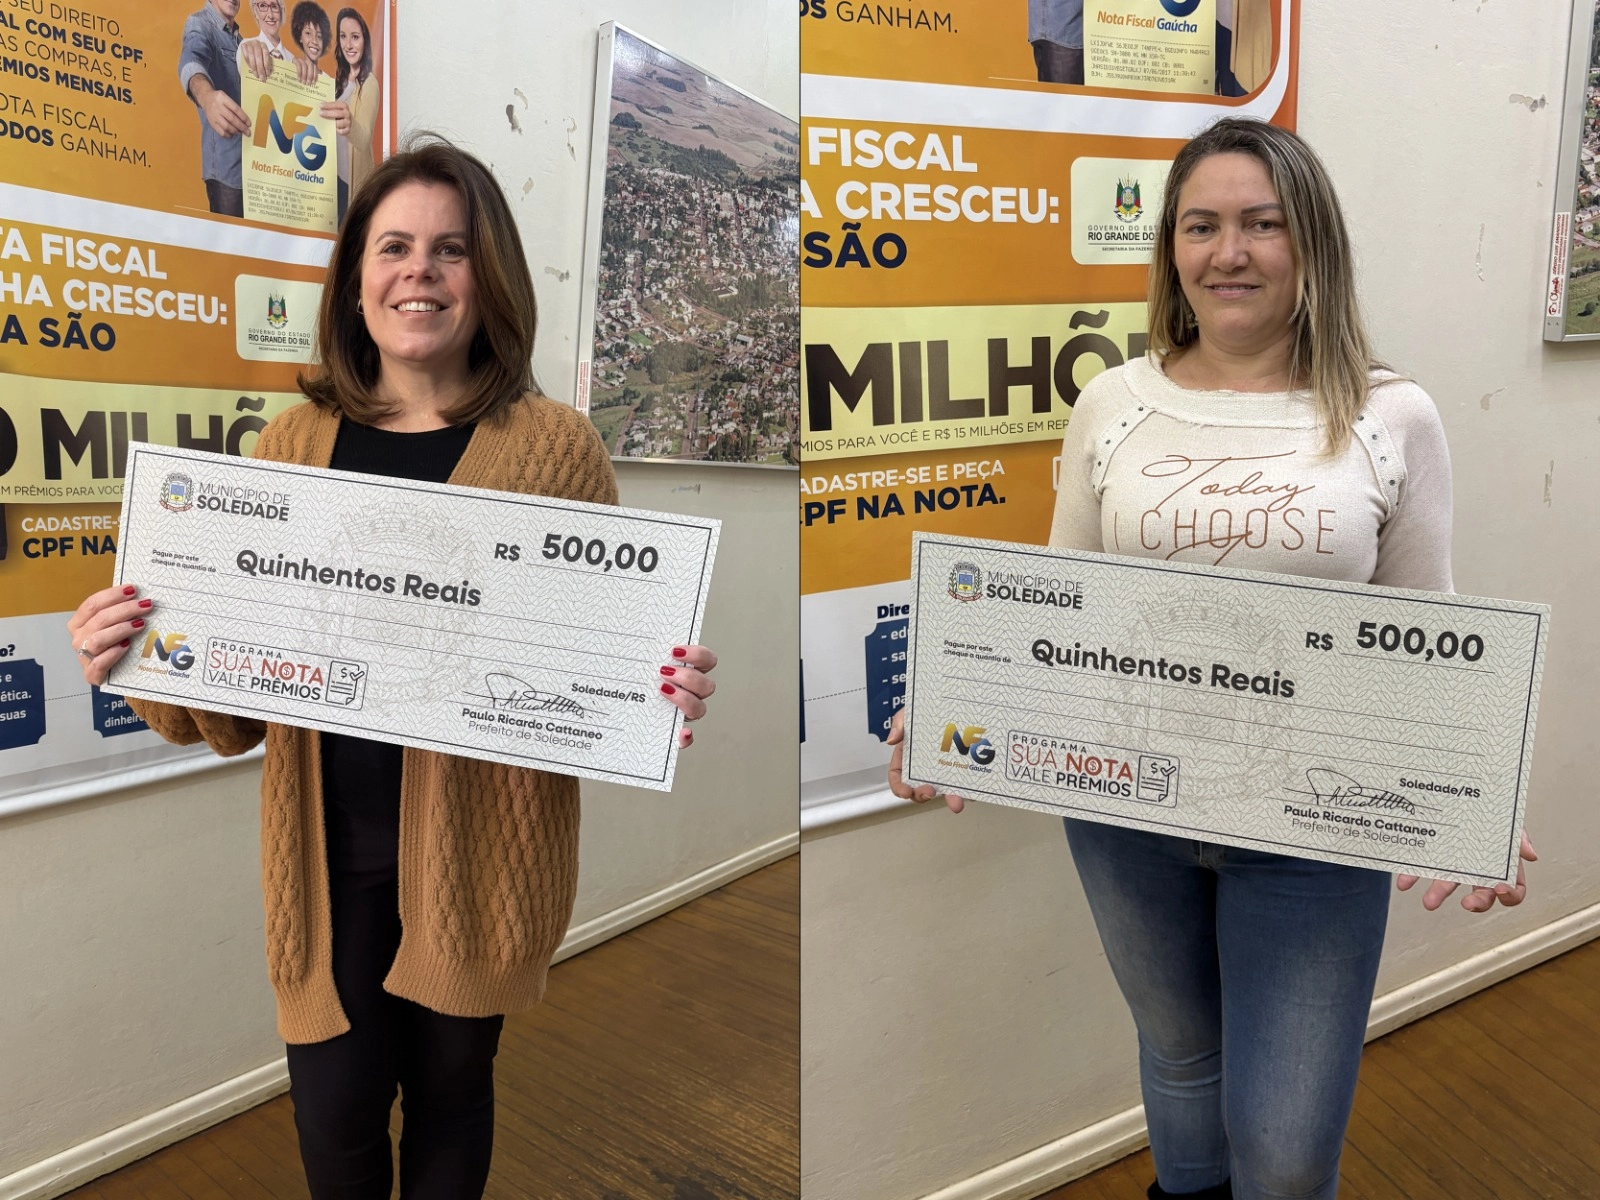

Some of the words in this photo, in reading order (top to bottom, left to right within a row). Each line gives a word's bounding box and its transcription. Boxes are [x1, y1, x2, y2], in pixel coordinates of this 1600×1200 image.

[50, 3, 124, 38] DIREITO.
[836, 1, 958, 34] GANHAM.
[1097, 10, 1124, 26] Nota
[1126, 14, 1156, 28] Fiscal
[1157, 18, 1198, 33] Gaúcha
[26, 18, 66, 44] COM
[72, 32, 106, 54] SEU
[111, 43, 146, 68] CPF,
[24, 40, 116, 81] COMPRAS,
[122, 66, 132, 82] E
[0, 56, 50, 82] MIOS
[56, 70, 136, 105] MENSAIS.
[44, 104, 117, 138] FISCAL,
[253, 94, 326, 171] NFG
[61, 134, 151, 168] GANHAM.
[808, 126, 978, 172] FISCAL
[252, 160, 272, 173] Nota
[272, 165, 294, 178] Fiscal
[294, 170, 324, 184] Gaúcha
[836, 180, 1060, 224] CRESCEU:
[803, 222, 908, 269] SÃO
[1088, 232, 1102, 240] RIO
[1104, 232, 1140, 240] GRANDE
[1142, 232, 1155, 240] DO
[0, 226, 32, 262] A
[41, 232, 168, 280] FISCAL
[62, 278, 228, 325] CRESCEU:
[0, 314, 28, 346] A
[38, 312, 116, 352] SÃO
[260, 336, 286, 344] GRANDE
[299, 338, 310, 346] SUL
[838, 436, 876, 450] PARA
[880, 428, 918, 446] VOCÊ
[922, 430, 931, 440] E
[934, 427, 950, 441] R$
[954, 427, 966, 438] 15
[969, 422, 1024, 438] MILHÕES
[1027, 420, 1044, 432] EM
[936, 464, 948, 482] E
[953, 460, 1006, 481] PEÇA
[1141, 450, 1316, 512] Today
[14, 485, 63, 496] PRÊMIOS
[66, 486, 95, 496] PARA
[199, 482, 269, 502] MUNICÍPIO
[273, 492, 290, 506] DE
[800, 498, 846, 526] PF
[857, 493, 904, 520] NA
[914, 482, 1006, 514] NOTA.
[196, 495, 290, 521] SOLEDADE
[22, 537, 74, 558] CPF
[82, 535, 116, 556] NA
[1141, 508, 1336, 554] CHOOSE
[152, 558, 175, 568] cheque
[182, 562, 206, 572] quantia
[153, 549, 172, 558] Pague
[174, 554, 184, 562] por
[494, 543, 520, 564] R$
[542, 533, 658, 573] 500,00
[237, 550, 396, 594] Quinhentos
[403, 574, 482, 606] Reais
[988, 571, 1060, 590] MUNICÍPIO
[1064, 580, 1084, 593] DE
[986, 584, 1083, 610] SOLEDADE
[212, 642, 282, 659] PROGRAMA
[944, 640, 965, 648] Pague
[966, 644, 978, 652] por
[944, 649, 968, 658] cheque
[975, 654, 1001, 662] quantia
[1306, 632, 1333, 652] R$
[1357, 621, 1484, 662] 500,00
[209, 650, 253, 674] SUA
[261, 659, 324, 686] NOTA
[1031, 639, 1202, 684] Quinhentos
[1211, 664, 1295, 698] Reais
[208, 670, 246, 688] VALE
[250, 676, 322, 700] PRÊMIOS
[571, 683, 646, 703] Soledade/RS
[462, 708, 495, 722] Paulo
[498, 714, 542, 730] Ricardo
[546, 722, 603, 740] Cattaneo
[468, 720, 514, 736] Prefeito
[516, 729, 532, 740] de
[535, 732, 592, 750] Soledade
[1012, 734, 1087, 752] PROGRAMA
[969, 764, 992, 774] Gaúcha
[1010, 744, 1057, 769] SUA
[1066, 752, 1134, 782] NOTA
[1010, 764, 1050, 784] VALE
[1056, 772, 1132, 797] PRÊMIOS
[1400, 778, 1481, 798] Soledade/RS
[1284, 805, 1320, 819] Paulo
[1322, 811, 1371, 828] Ricardo
[1374, 820, 1436, 837] Cattaneo
[1292, 818, 1340, 835] Prefeito
[1344, 826, 1360, 837] de
[1364, 830, 1426, 848] Soledade
